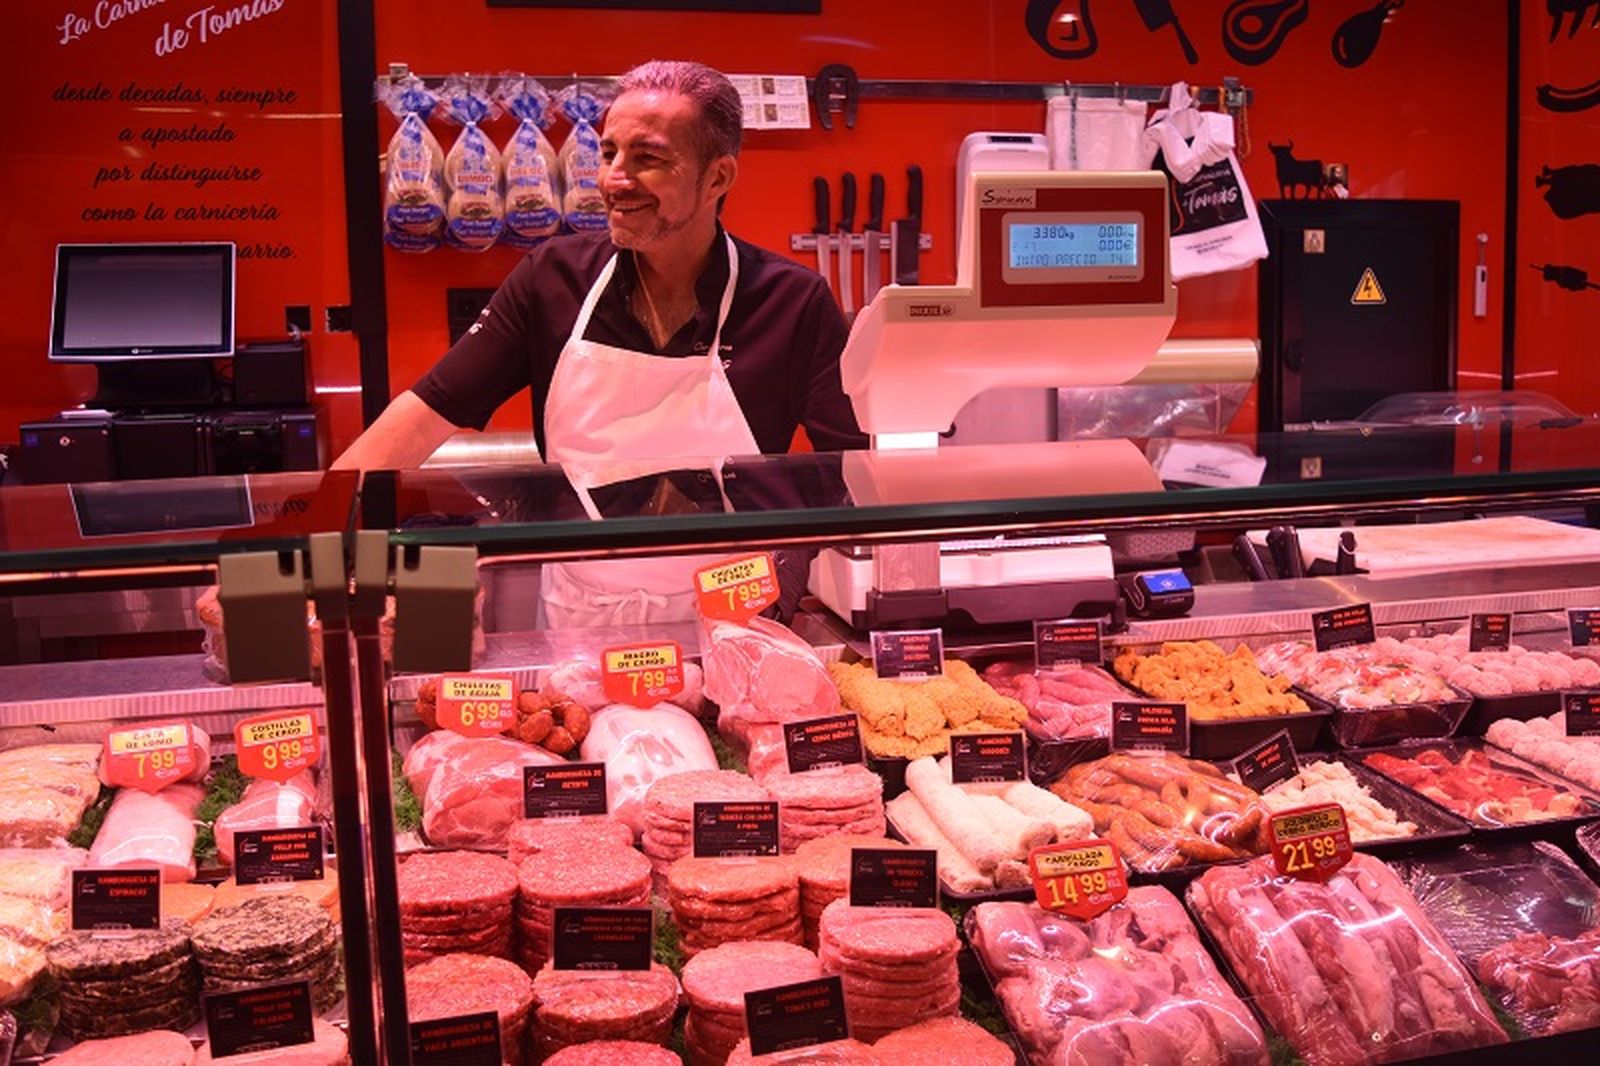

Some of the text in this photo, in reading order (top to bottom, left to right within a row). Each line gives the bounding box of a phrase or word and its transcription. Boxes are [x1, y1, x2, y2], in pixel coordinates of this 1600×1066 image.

[57, 13, 91, 44] La
[155, 23, 188, 56] de
[53, 82, 111, 101] desde
[216, 85, 297, 110] siempre
[117, 123, 237, 149] a apostado
[92, 162, 263, 188] por distinguirse
[81, 202, 281, 222] como la carnicería
[236, 243, 297, 260] arrio.
[250, 719, 302, 733] COSTILLAS
[125, 741, 138, 749] DE
